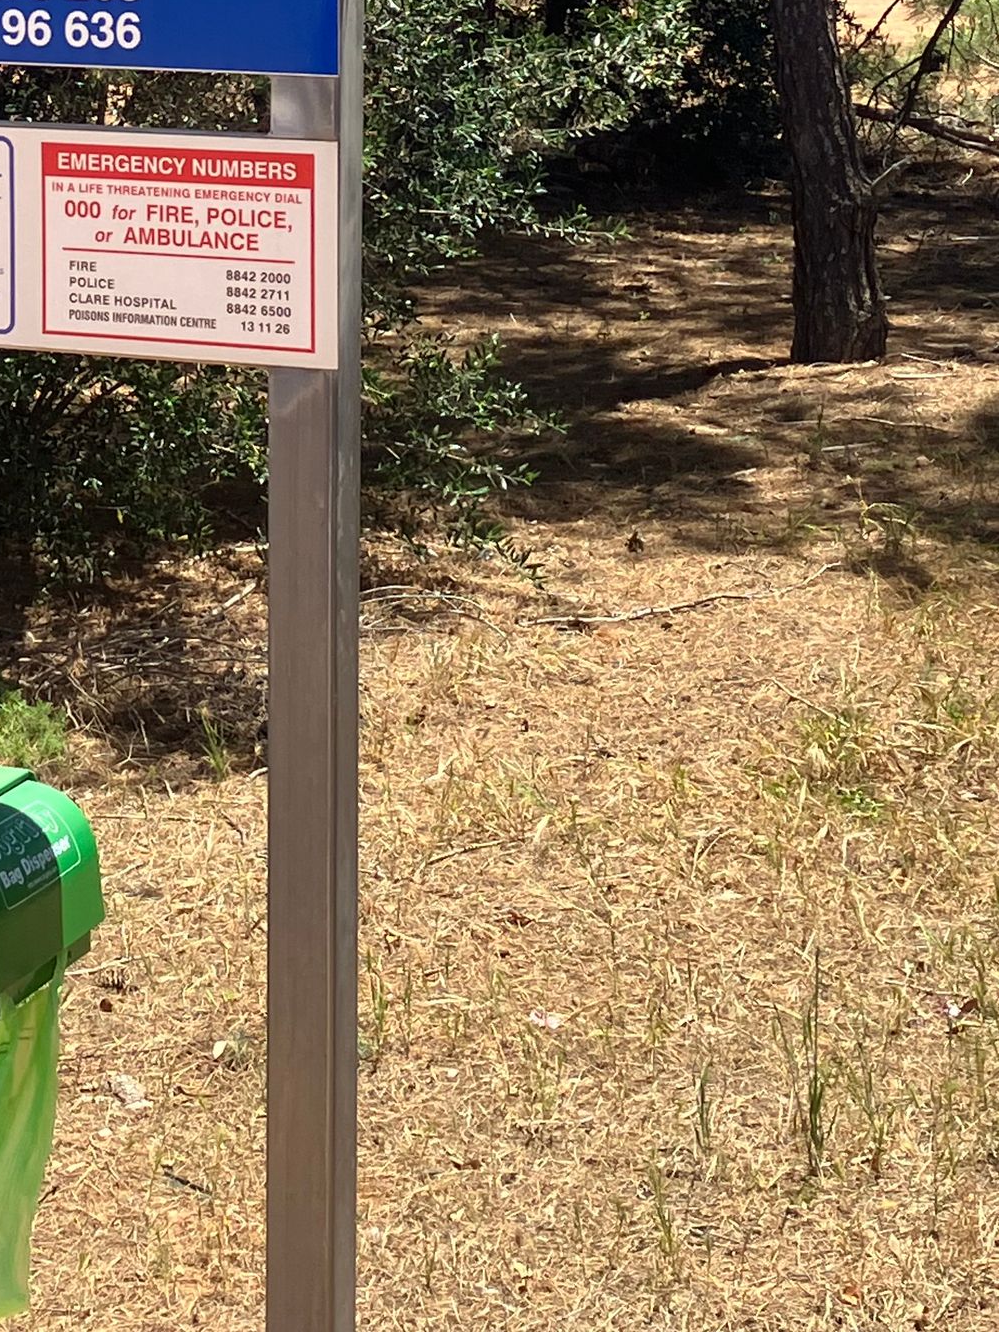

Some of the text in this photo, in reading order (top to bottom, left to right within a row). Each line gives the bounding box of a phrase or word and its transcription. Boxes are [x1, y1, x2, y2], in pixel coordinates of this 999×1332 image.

[65, 11, 140, 49] 636
[59, 153, 296, 180] EMERGENCY NUMBERS
[52, 181, 302, 204] IN A LIFE THREATENING EMERGENCY DIAL
[65, 200, 292, 232] 000 for FIRE, POLICE,
[95, 227, 259, 251] or AMBULANCE
[69, 260, 96, 272] FIRE
[69, 277, 114, 289] POLICE
[226, 270, 291, 284] 8842 2000
[69, 293, 177, 310] CLARE HOSPITAL
[226, 287, 289, 301] 8842 2711
[227, 303, 291, 317] 8842 6500
[69, 309, 216, 329] POISONS INFORMATION CENTRE
[241, 321, 290, 334] 13 11 26
